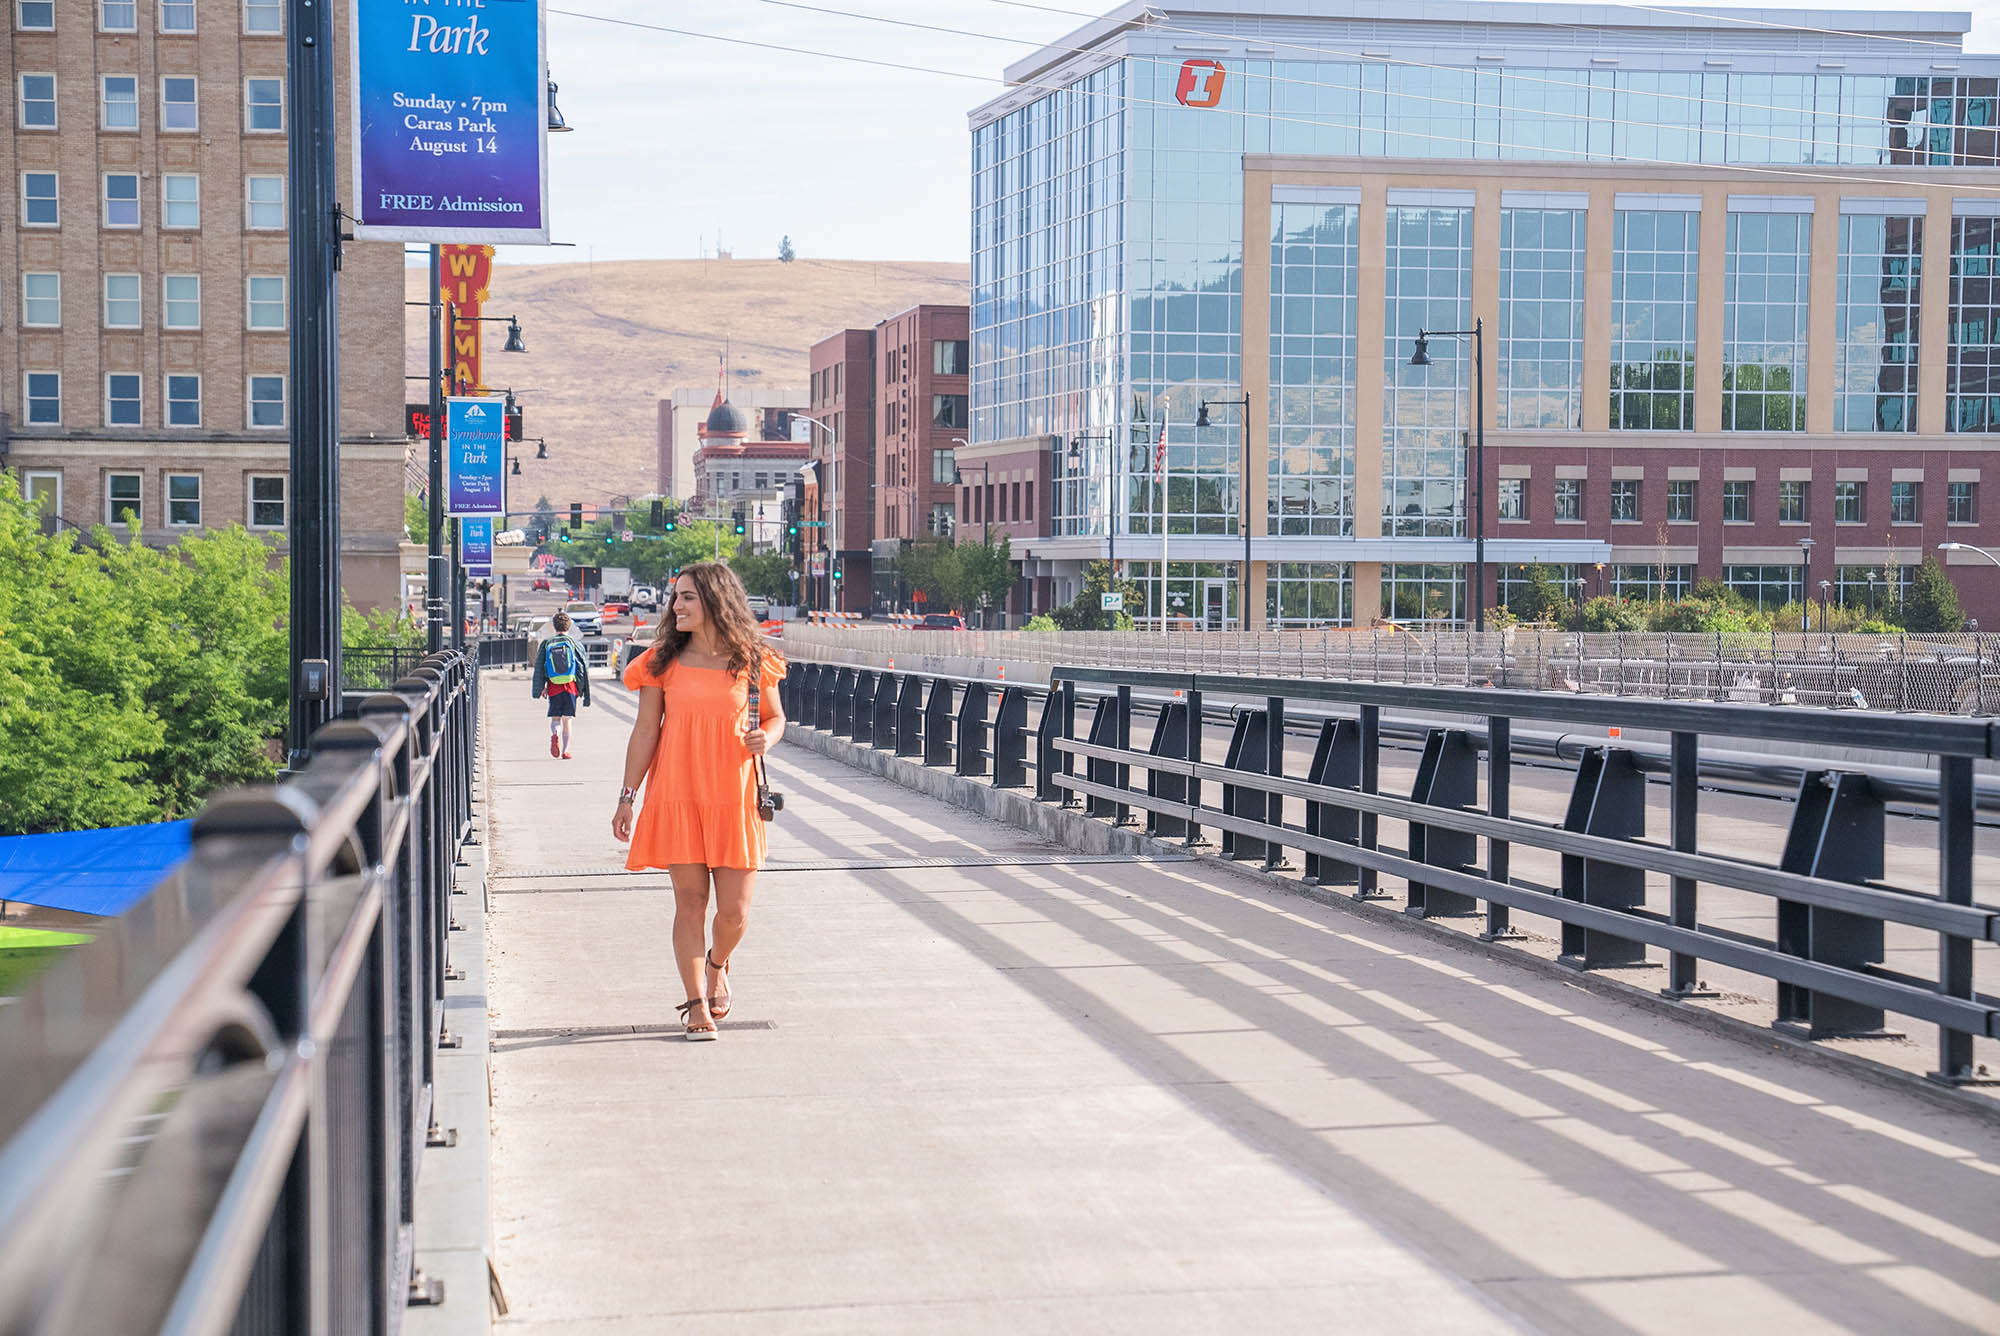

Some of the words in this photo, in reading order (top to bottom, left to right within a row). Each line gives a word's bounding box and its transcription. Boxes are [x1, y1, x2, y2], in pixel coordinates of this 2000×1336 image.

[407, 14, 490, 56] Park
[392, 92, 456, 114] Sunday
[471, 96, 508, 115] 7pm
[404, 114, 453, 132] Caras
[457, 117, 497, 133] Park
[409, 136, 468, 156] August
[476, 136, 498, 154] 14
[379, 194, 434, 210] FREE
[437, 195, 524, 213] Admission
[449, 254, 477, 384] WILMA
[451, 427, 502, 442] Symphony
[474, 443, 487, 451] THE
[463, 451, 489, 464] Park
[1104, 596, 1113, 607] P
